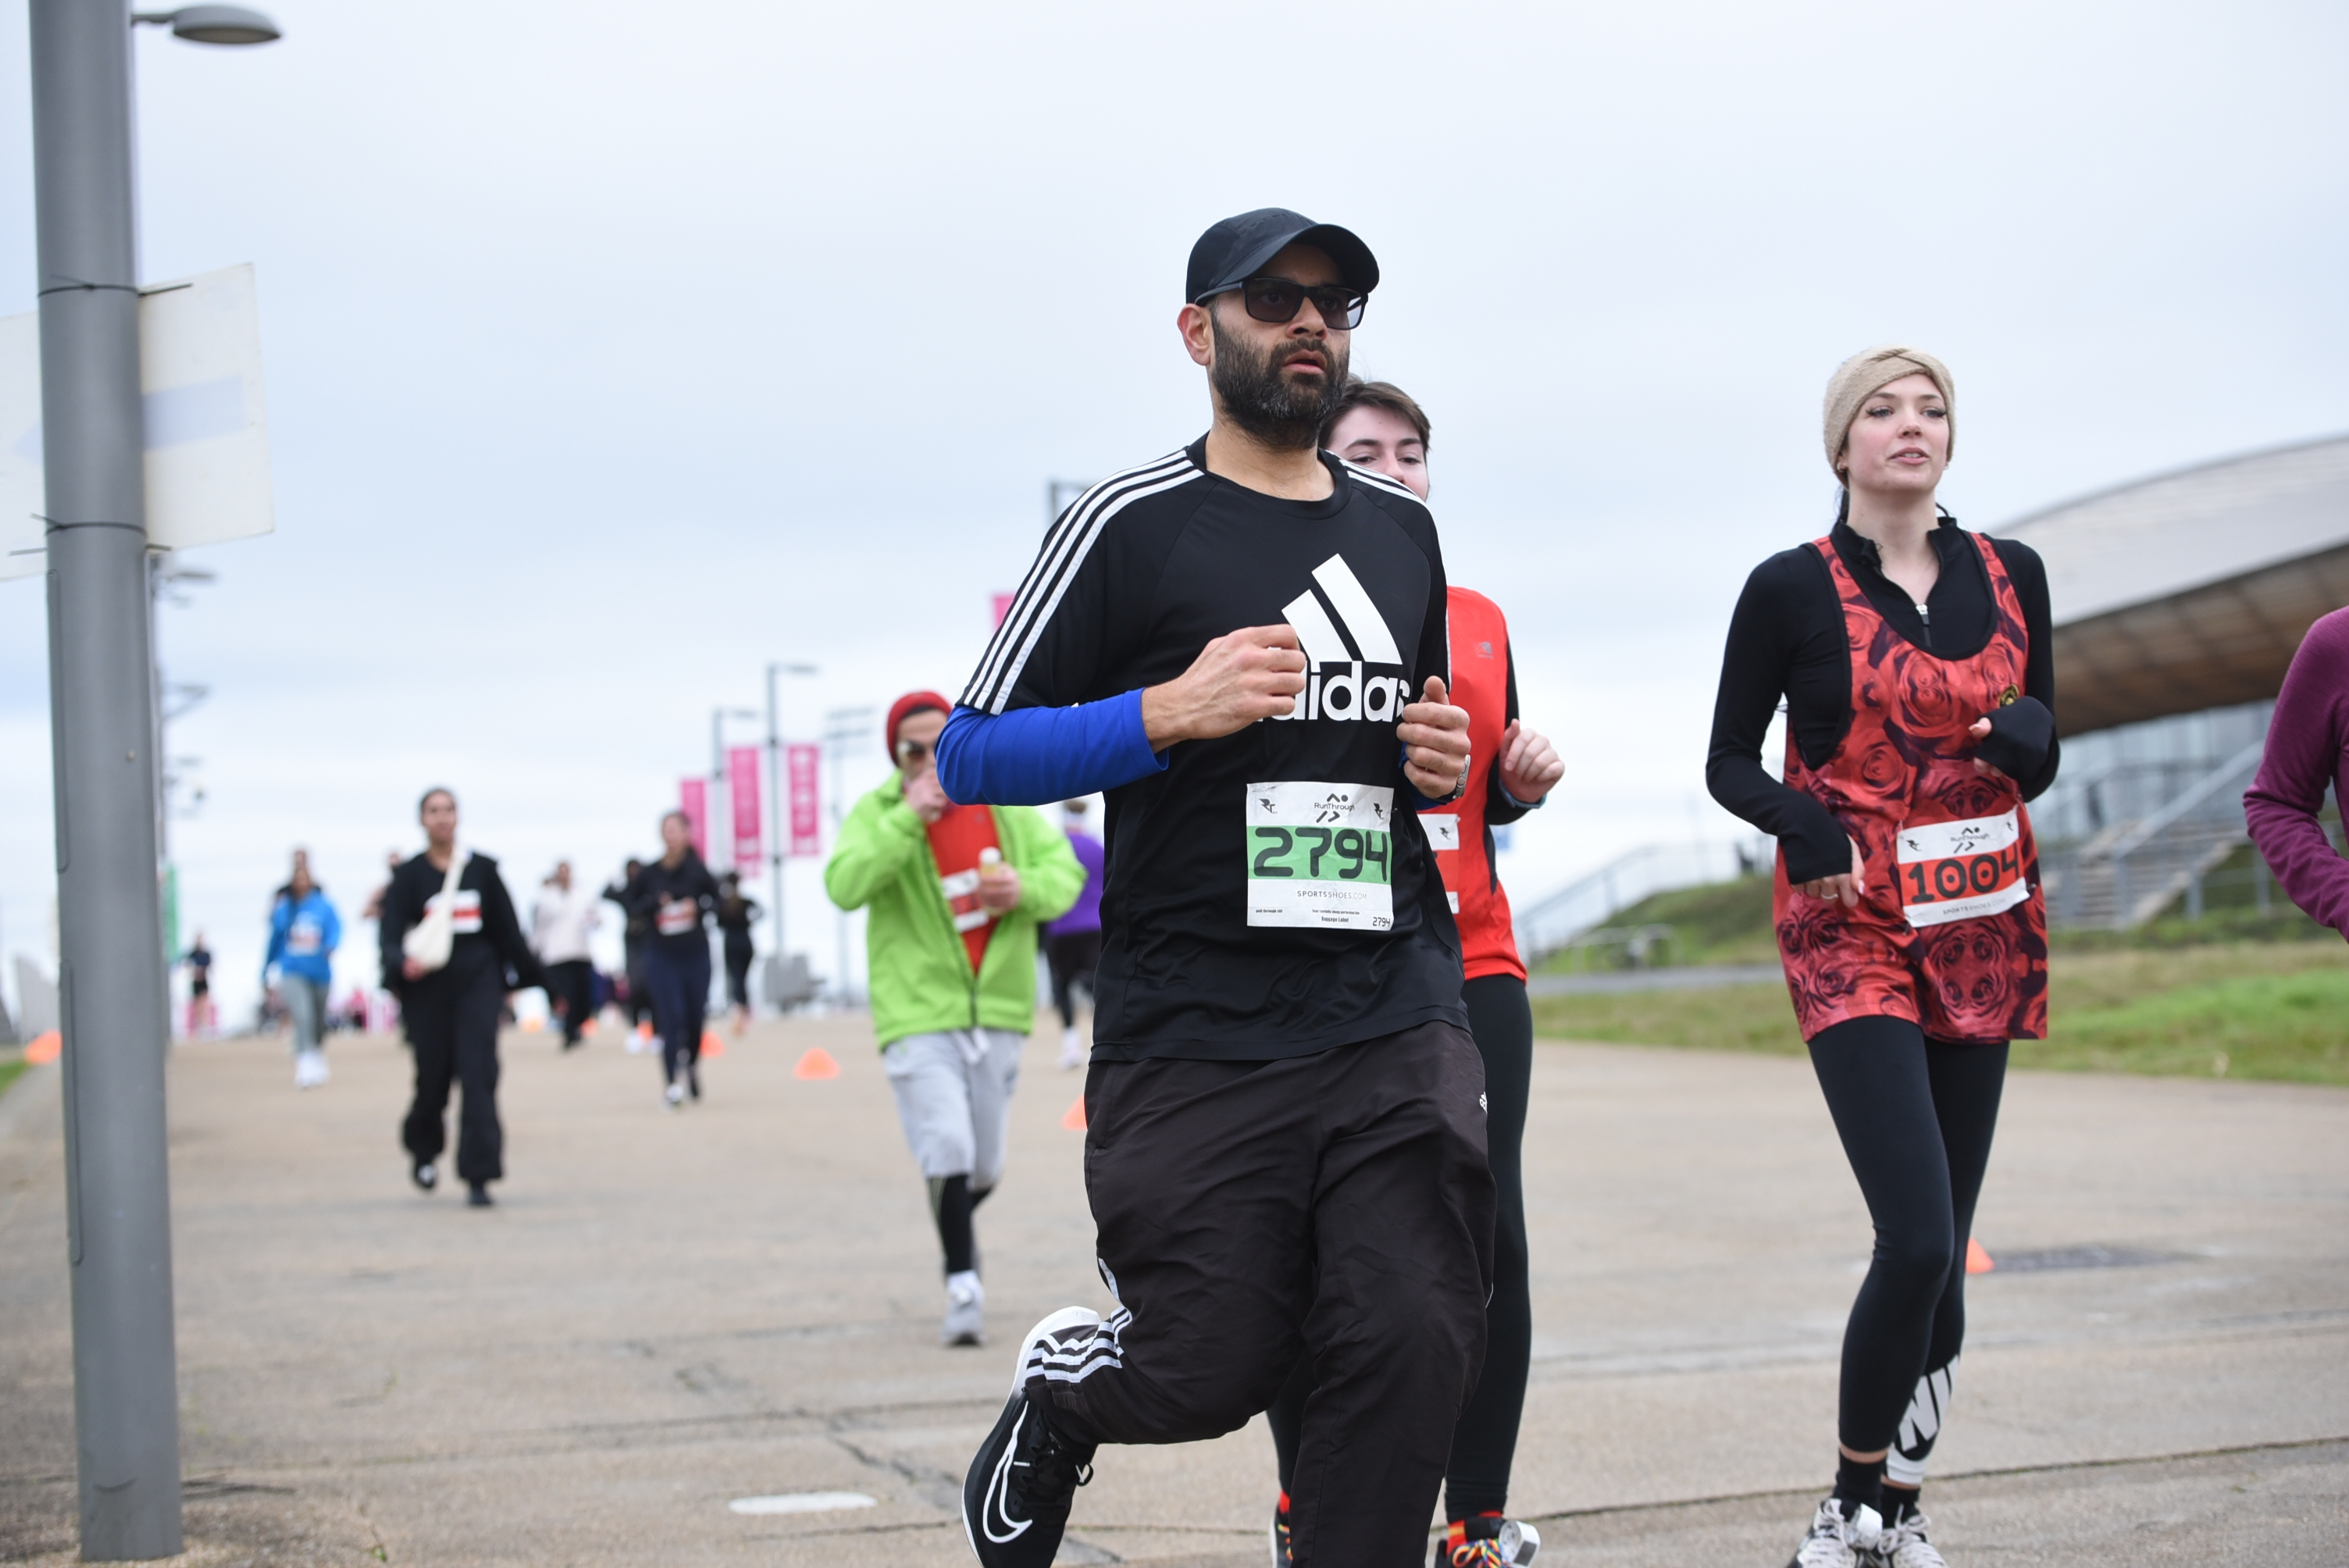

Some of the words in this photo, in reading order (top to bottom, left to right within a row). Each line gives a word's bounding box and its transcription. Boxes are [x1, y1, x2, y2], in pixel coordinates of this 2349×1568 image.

[1256, 660, 1410, 722] idas
[1314, 802, 1355, 812] RunThrough
[1253, 826, 1388, 882] 2794
[1908, 841, 2019, 903] 1004
[1297, 889, 1367, 900] SPORTSSHOES.COM
[1372, 916, 1391, 928] 2794
